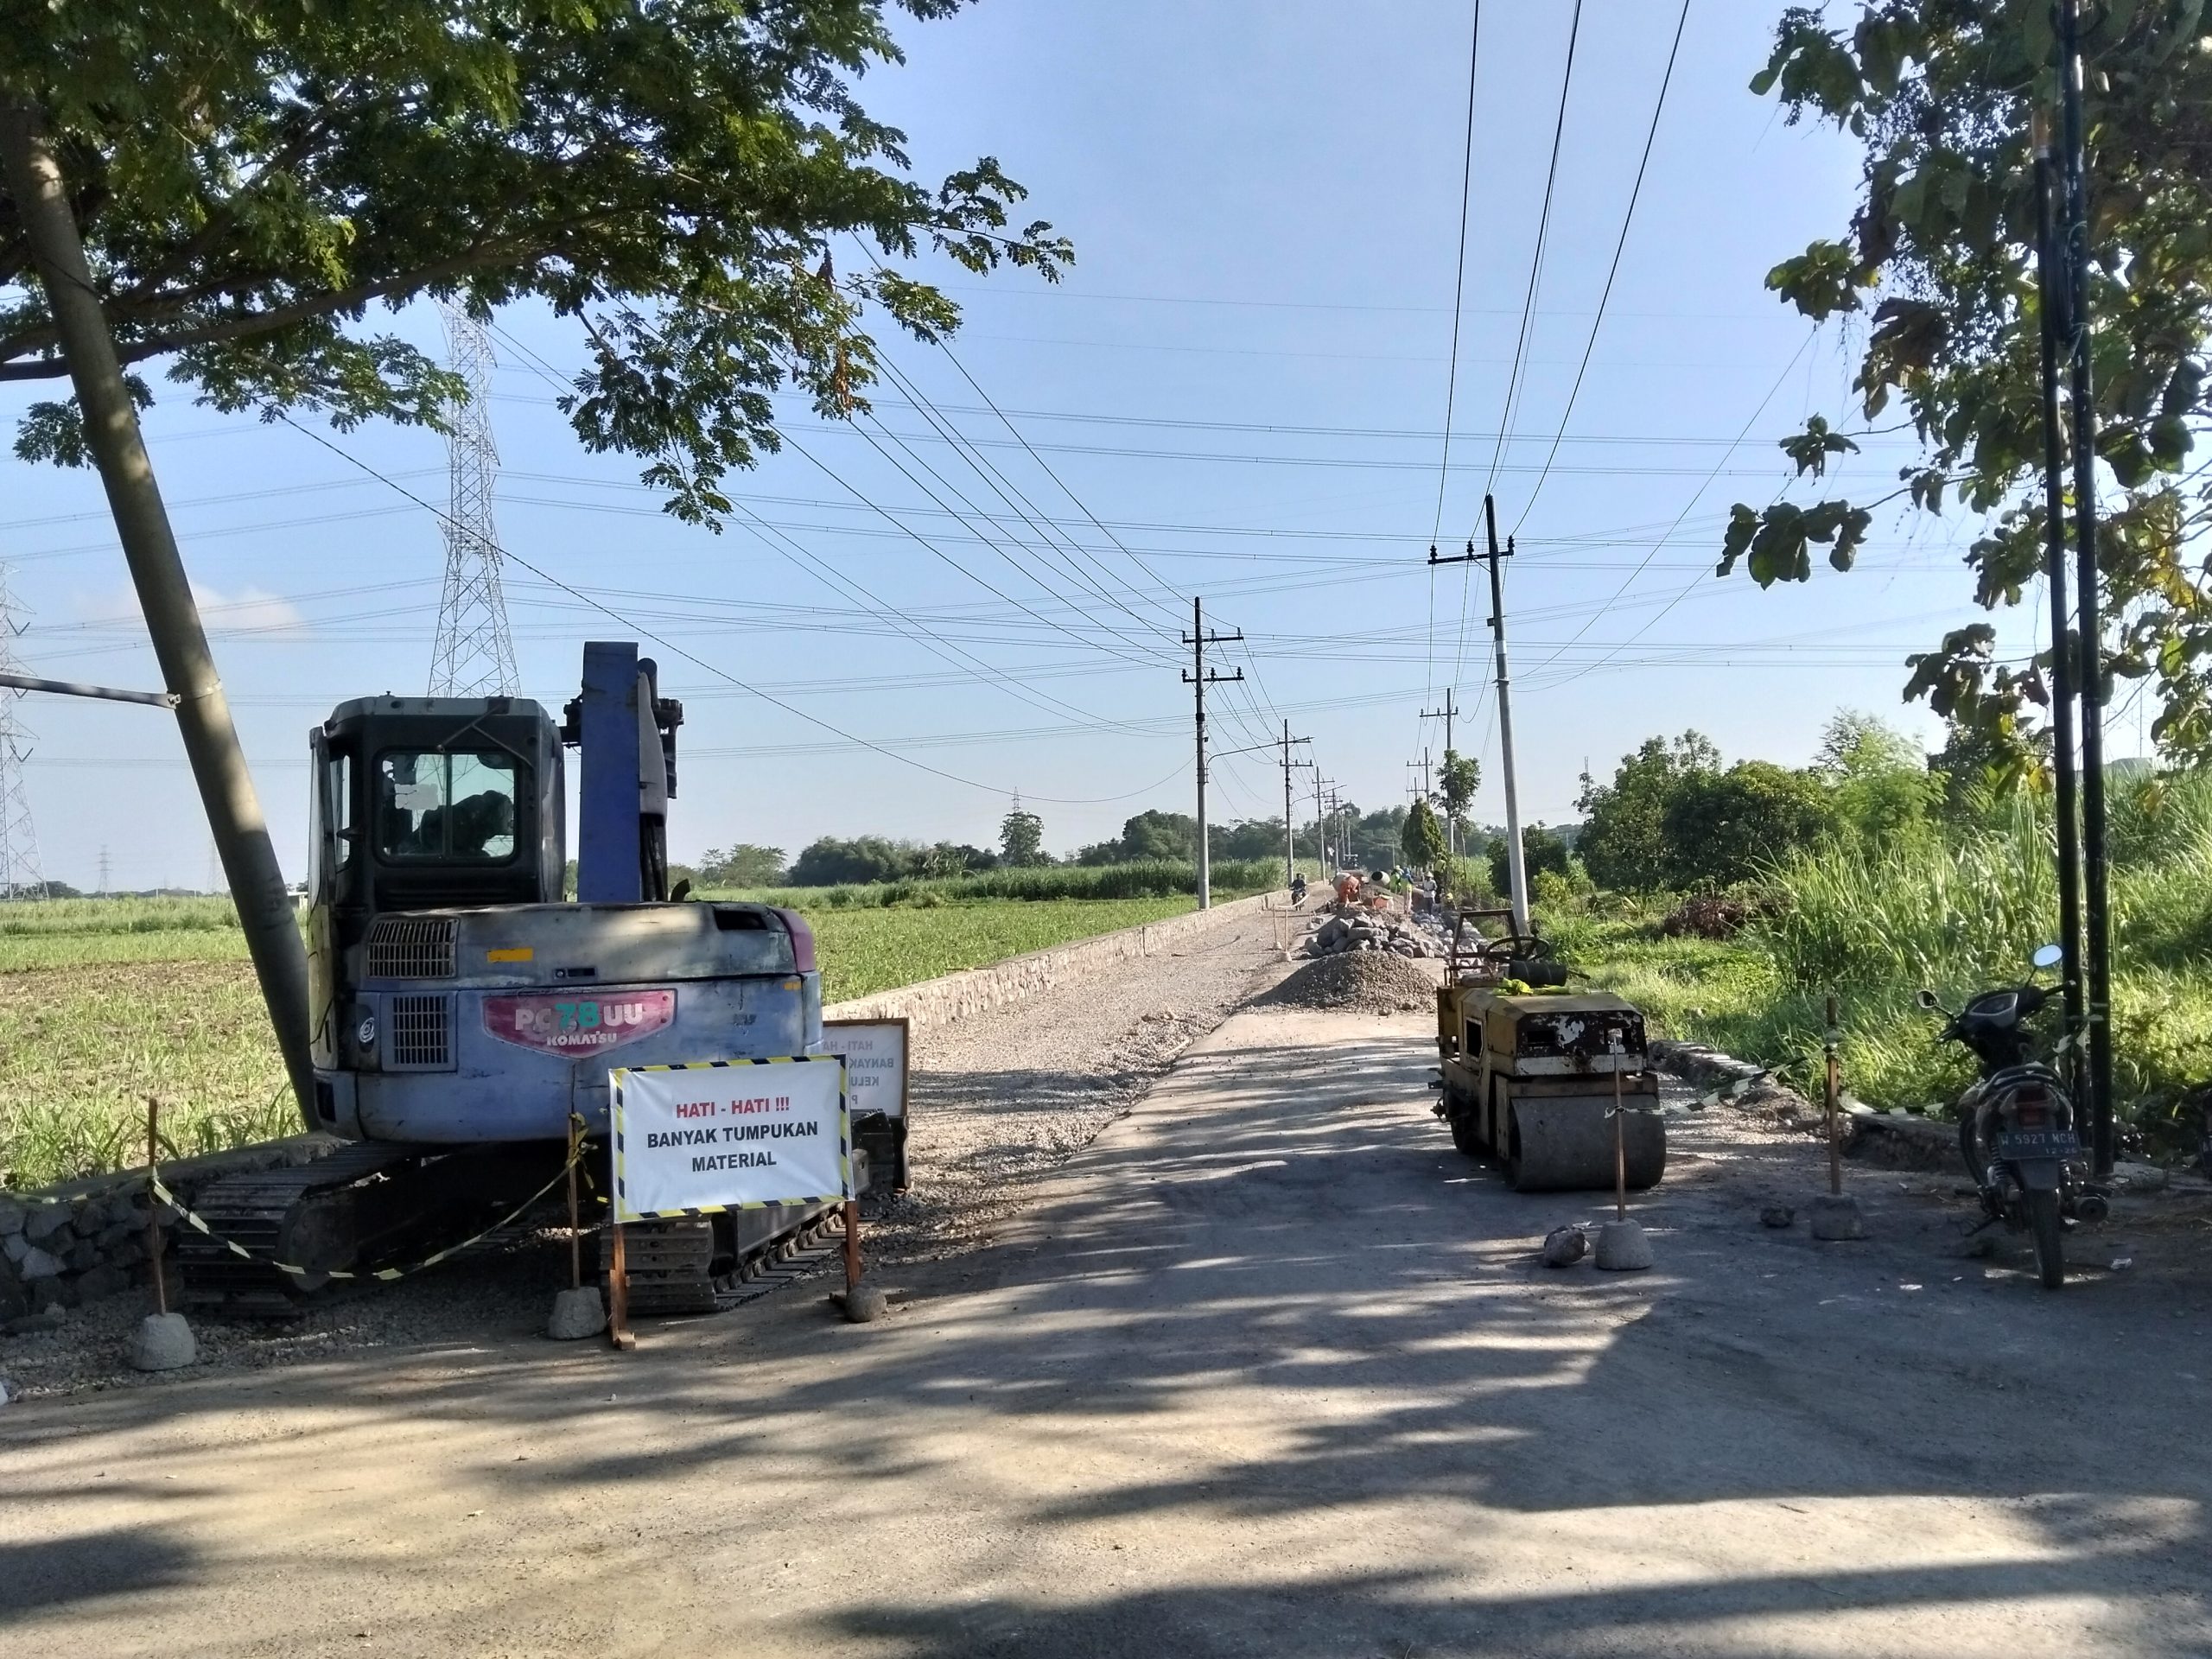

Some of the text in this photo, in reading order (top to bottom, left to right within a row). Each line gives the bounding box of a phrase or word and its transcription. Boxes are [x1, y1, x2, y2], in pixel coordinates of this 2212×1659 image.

[546, 1033, 617, 1046] KOMATSU
[676, 1102, 715, 1118] HATI
[731, 1098, 770, 1115] HATI
[775, 1096, 790, 1112] !!!
[647, 1121, 818, 1148] BANYAK TUMPUKAN
[1999, 1135, 2009, 1145] W
[2014, 1133, 2045, 1144] 5927
[692, 1151, 777, 1173] MATERIAL
